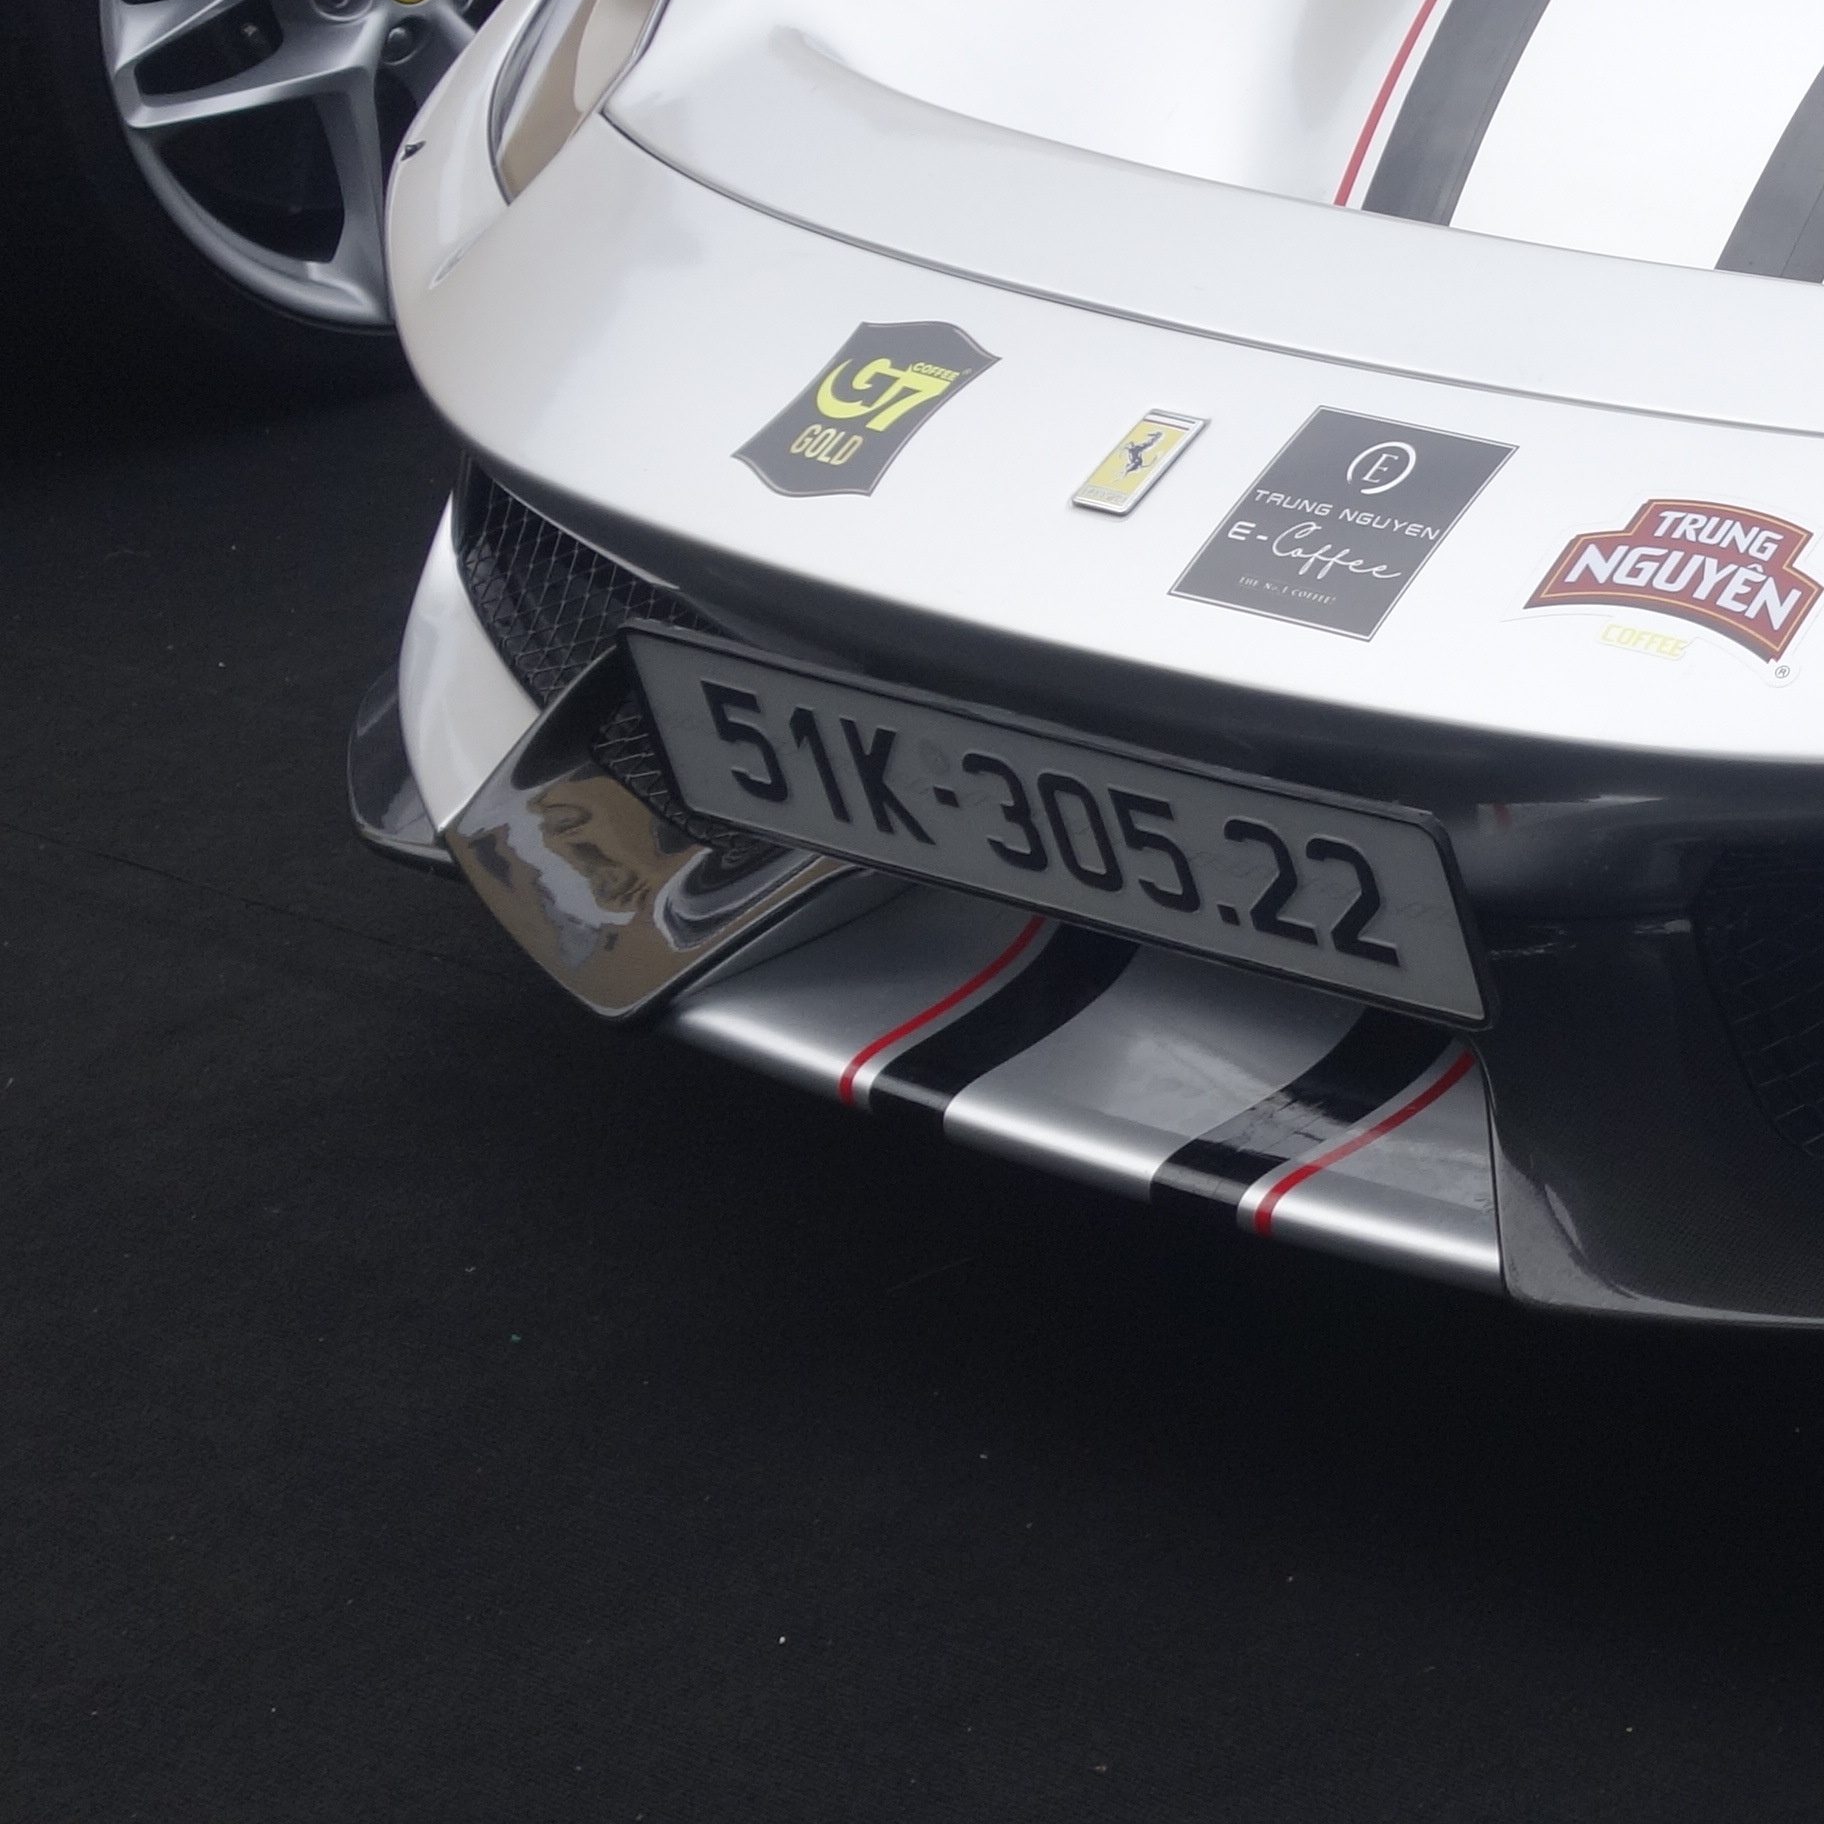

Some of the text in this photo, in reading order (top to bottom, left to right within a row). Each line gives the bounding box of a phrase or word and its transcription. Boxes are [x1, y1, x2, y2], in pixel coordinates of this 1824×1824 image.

[816, 358, 952, 432] G7
[911, 361, 961, 382] COFFEE
[790, 423, 864, 466] GOLD
[1254, 488, 1442, 542] TRUNG NGUYEN
[1653, 510, 1784, 562] TRUNG
[1563, 543, 1803, 632] NGUYÊN
[1601, 623, 1690, 659] COFFEE
[699, 679, 1402, 967] 51K-305.22
